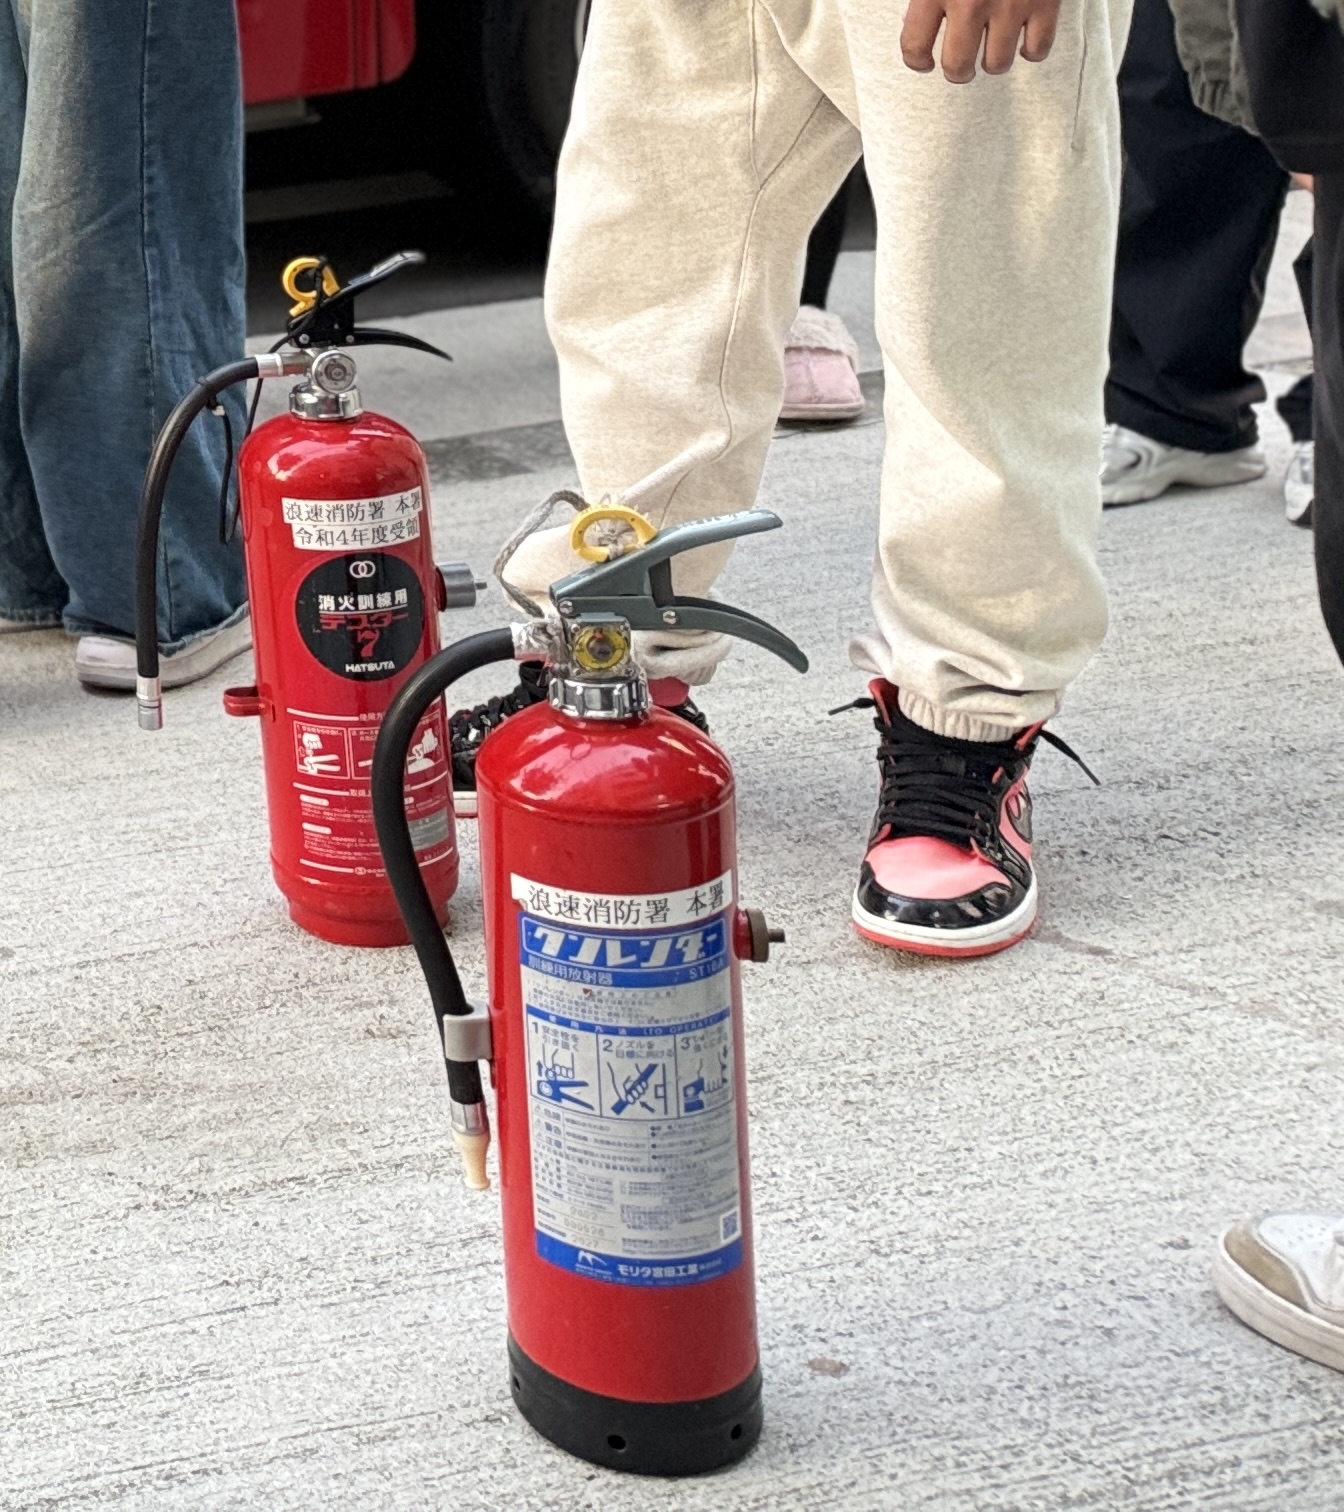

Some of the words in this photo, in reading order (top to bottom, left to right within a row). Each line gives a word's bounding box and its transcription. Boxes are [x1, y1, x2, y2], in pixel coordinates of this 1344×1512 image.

[285, 499, 386, 523] 浪速消防署
[395, 490, 421, 515] 本署
[295, 516, 418, 547] 令和4年度受領
[318, 588, 408, 611] 消火訓練用
[319, 612, 409, 631] テスター
[357, 629, 381, 657] 7
[345, 660, 395, 673] HATSUTA
[529, 885, 670, 926] 浪速消防署
[686, 880, 724, 917] 本署
[602, 1039, 613, 1052] 2
[681, 1037, 690, 1050] 3
